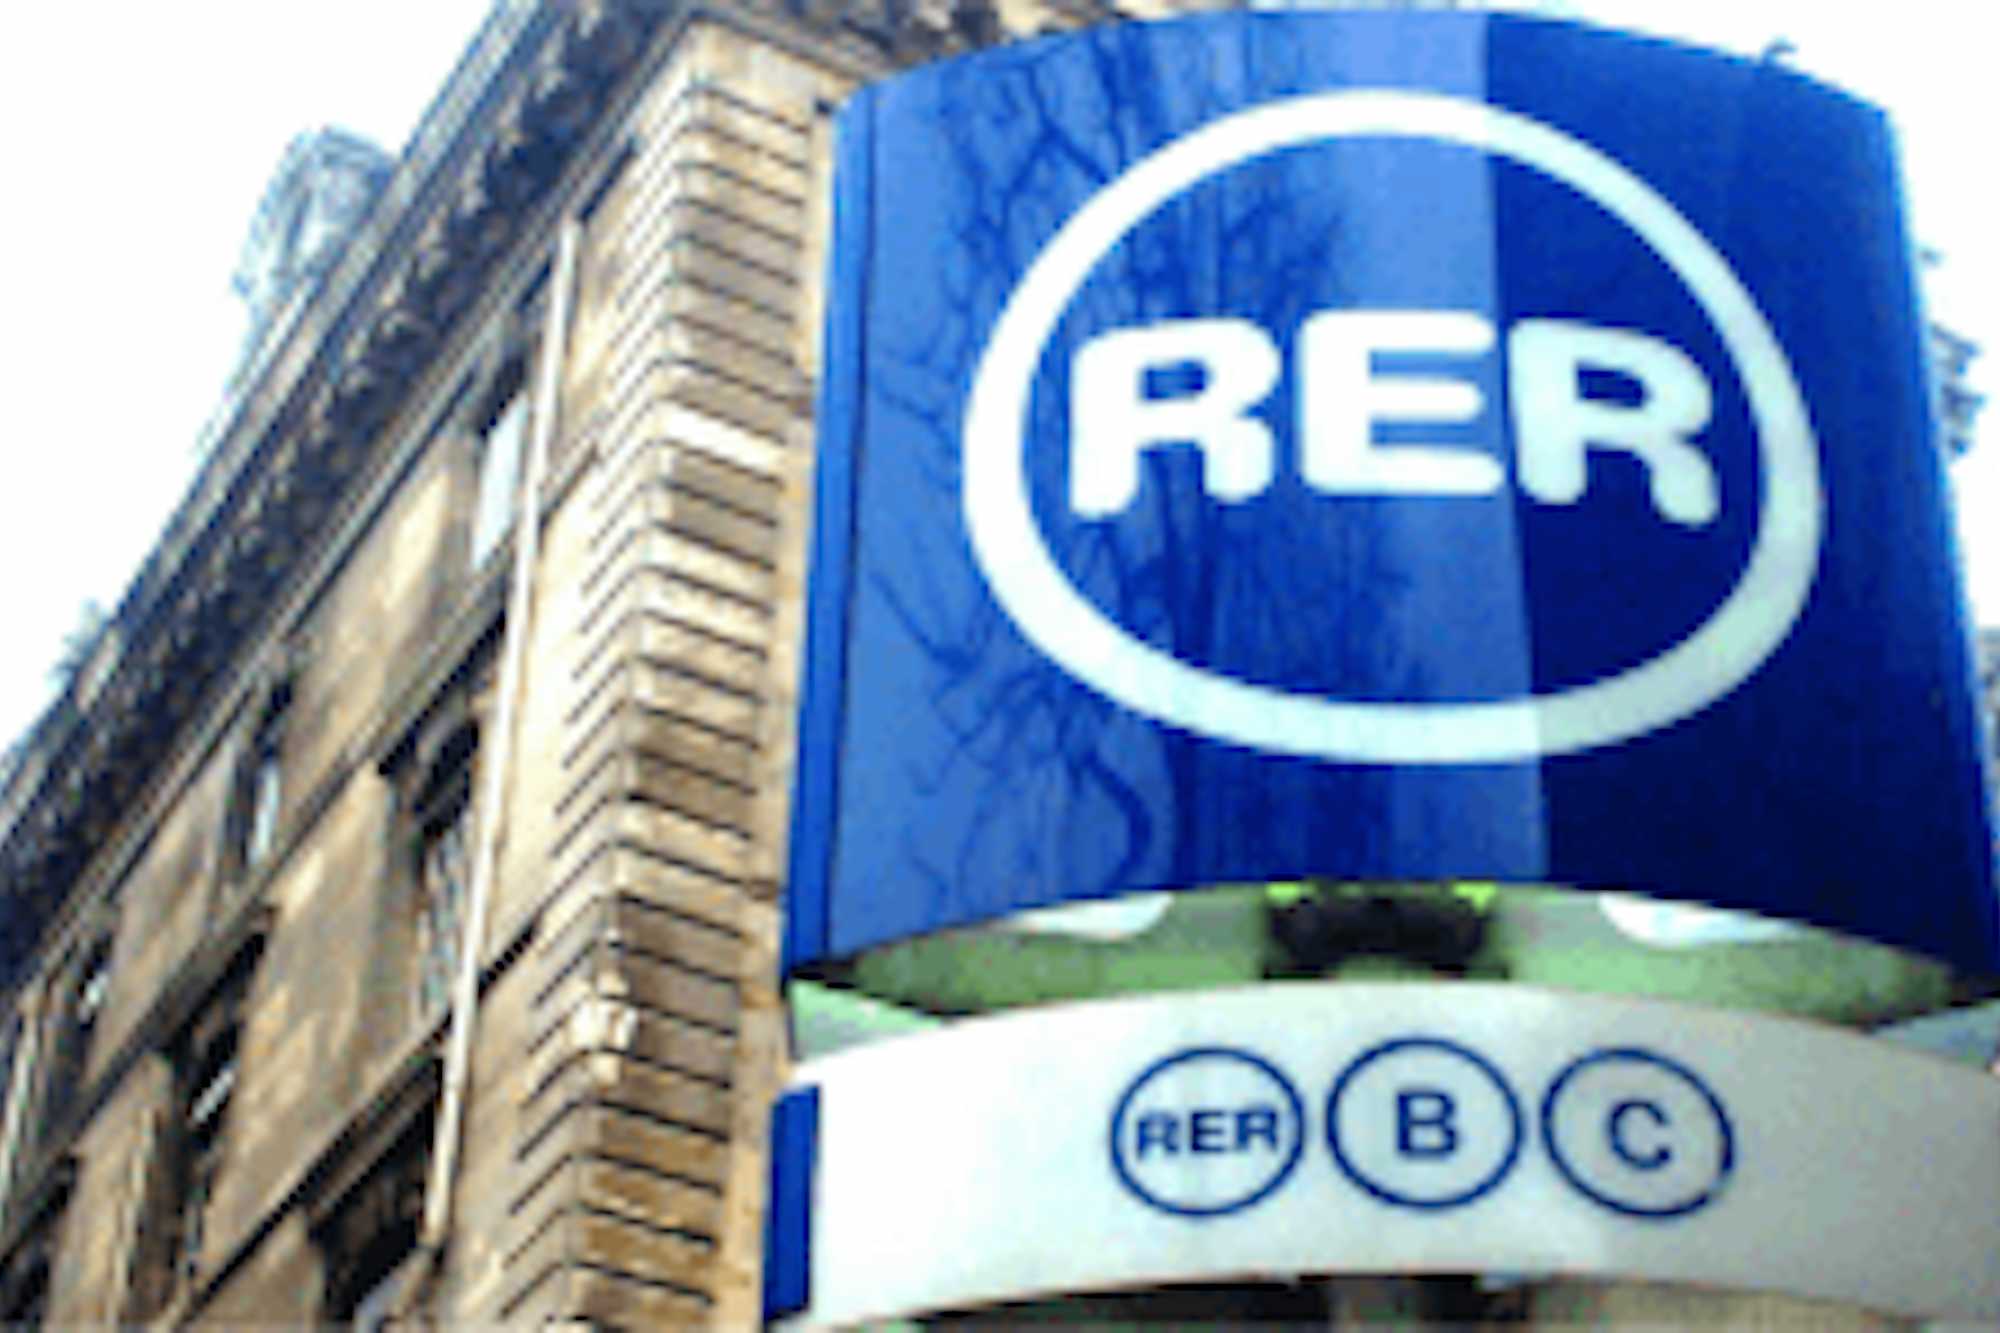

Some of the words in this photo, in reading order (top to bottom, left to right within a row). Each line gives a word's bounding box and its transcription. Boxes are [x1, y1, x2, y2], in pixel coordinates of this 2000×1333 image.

[1069, 309, 1719, 524] RER
[1135, 1104, 1280, 1160] RER
[1396, 1090, 1459, 1159] B
[1606, 1099, 1673, 1171] C
